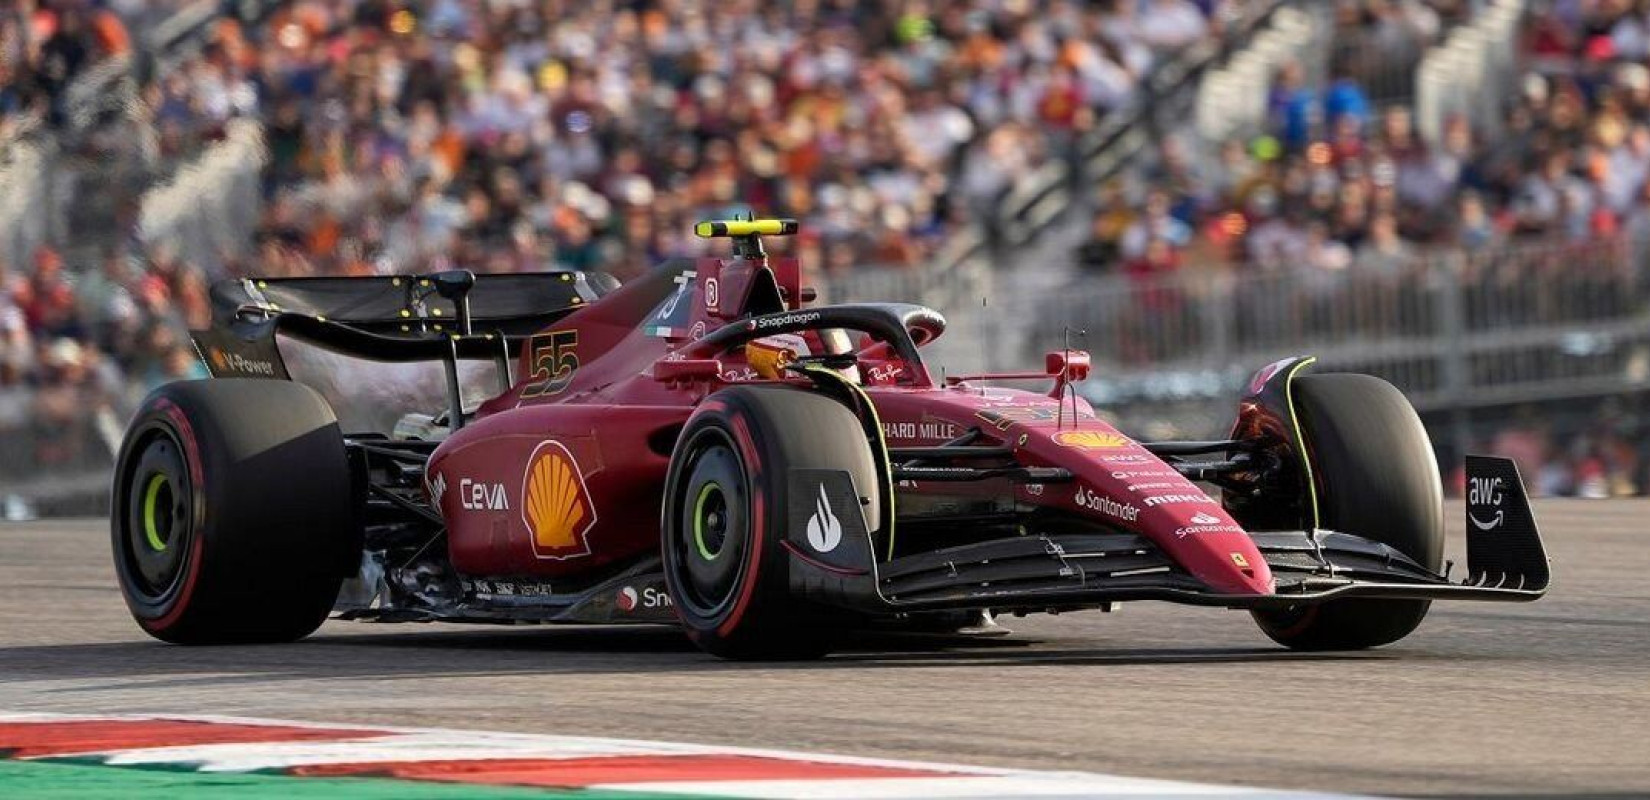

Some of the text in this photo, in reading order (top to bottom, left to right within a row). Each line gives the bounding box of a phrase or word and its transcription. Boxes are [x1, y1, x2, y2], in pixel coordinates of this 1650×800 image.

[758, 311, 821, 329] Snapdragon
[222, 352, 275, 375] V-Power
[520, 329, 580, 398] 55
[883, 422, 955, 439] HARD MILLE
[1469, 476, 1503, 506] aws
[1086, 490, 1141, 522] Santander
